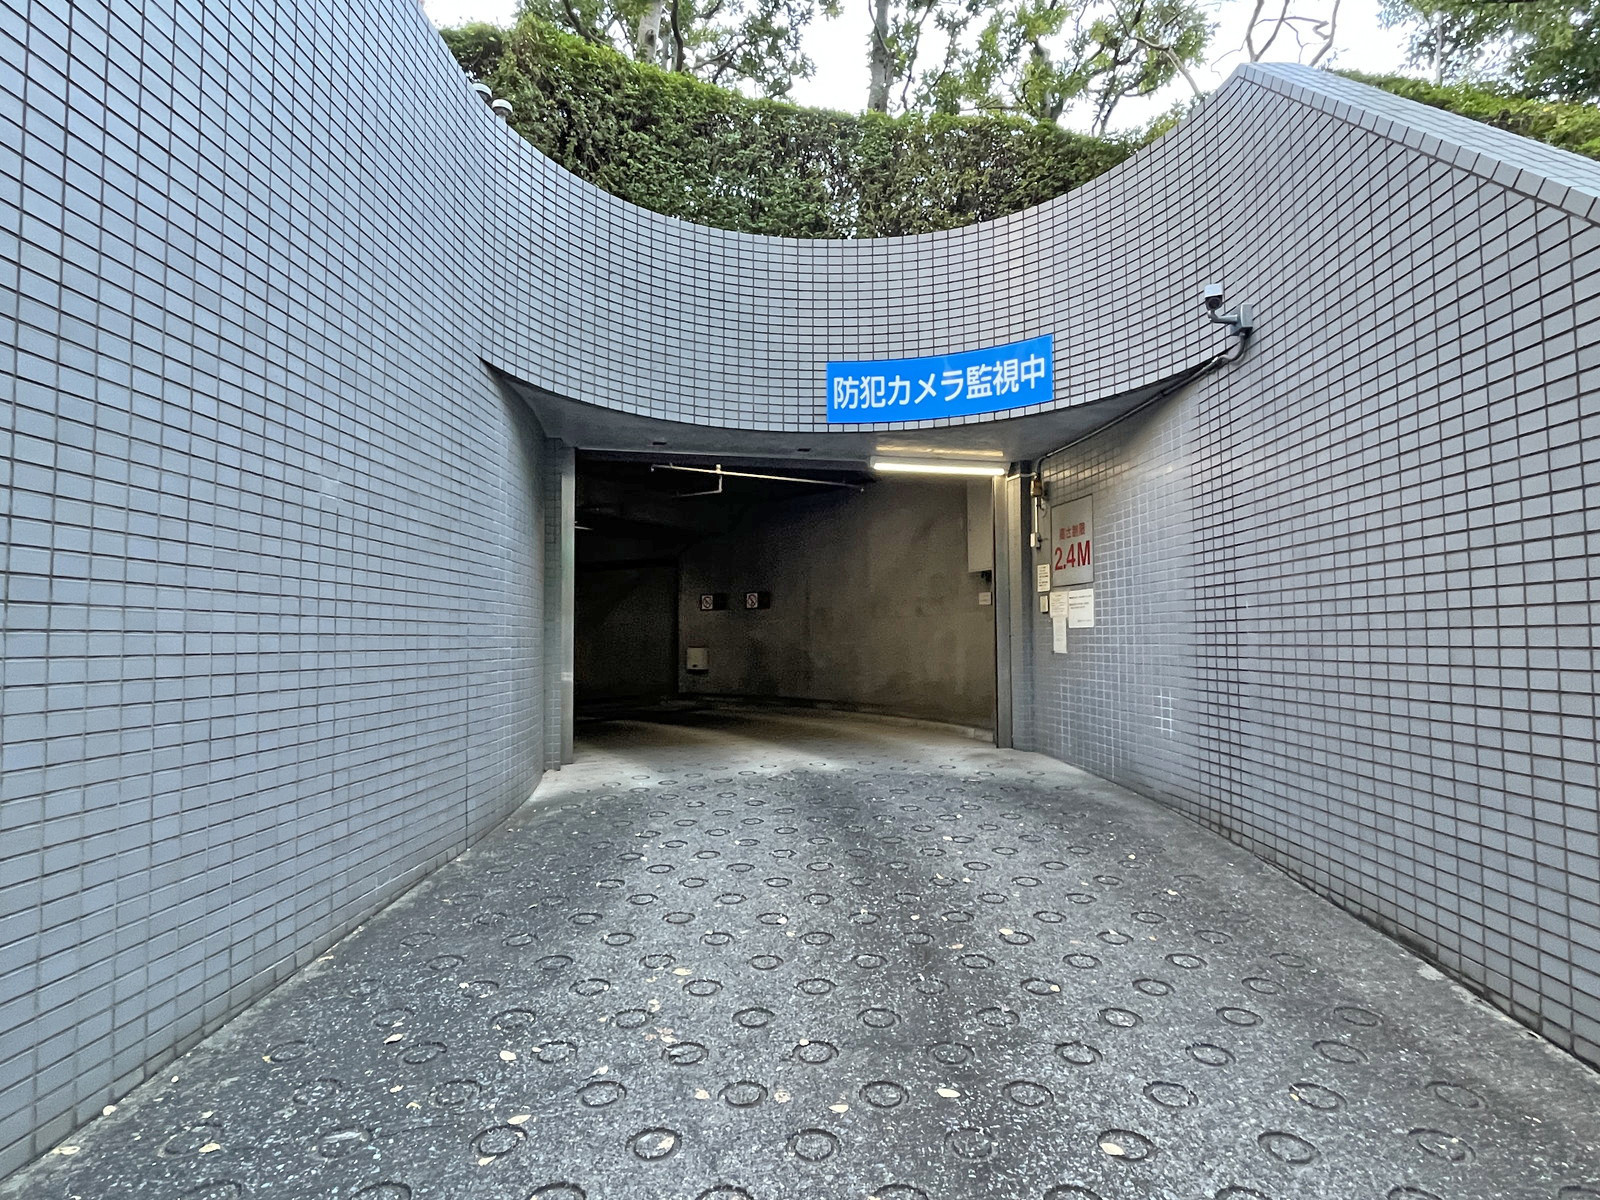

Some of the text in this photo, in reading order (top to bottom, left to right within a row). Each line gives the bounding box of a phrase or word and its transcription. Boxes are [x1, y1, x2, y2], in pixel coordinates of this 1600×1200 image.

[833, 353, 1045, 410] 防犯カメラ監視中
[1054, 540, 1091, 571] 2.4M
